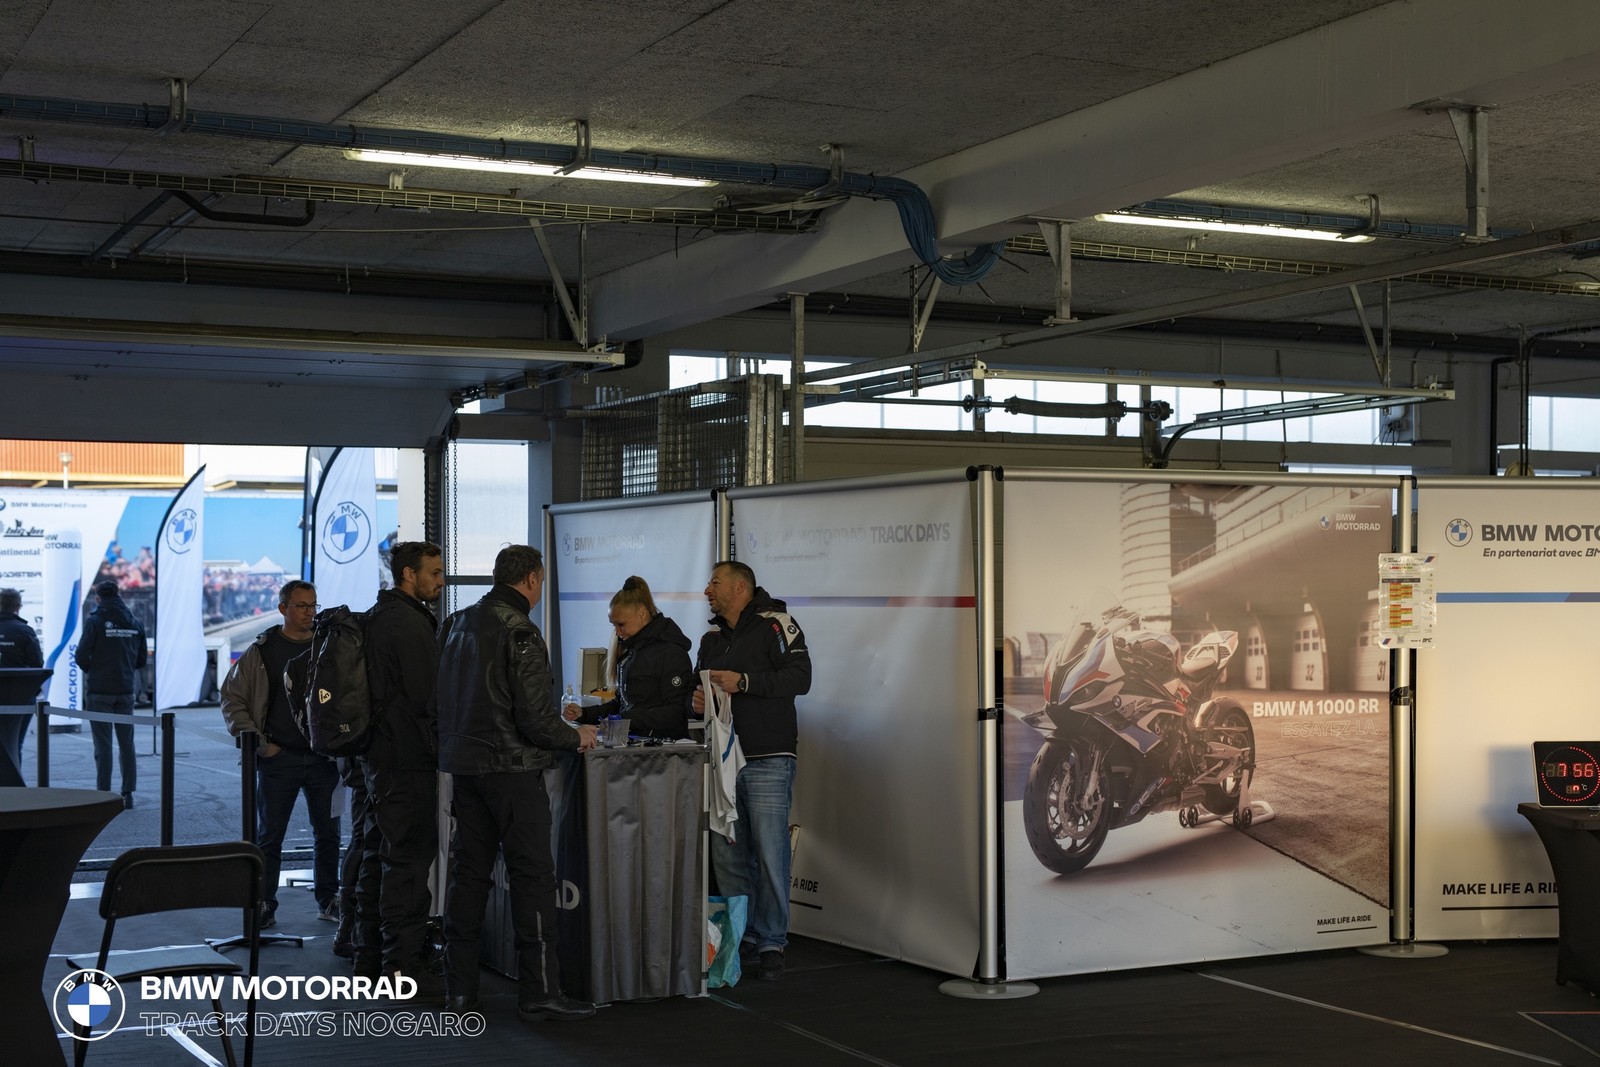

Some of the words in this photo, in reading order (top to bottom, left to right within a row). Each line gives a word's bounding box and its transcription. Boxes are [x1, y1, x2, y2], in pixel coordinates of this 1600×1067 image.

[1336, 513, 1356, 521] BMW
[871, 524, 914, 544] TRACK
[916, 522, 950, 542] DAYS
[1335, 522, 1381, 531] MOTORRAD
[1481, 525, 1537, 541] BMW
[574, 537, 594, 551] BMW
[1483, 548, 1496, 557] En
[1498, 548, 1557, 559] partenariat
[1377, 660, 1387, 681] 31
[69, 644, 77, 719] RACKDAYS
[1253, 701, 1296, 717] BMW
[1299, 700, 1314, 716] M
[1316, 699, 1356, 715] 1000
[1358, 698, 1380, 713] RR
[1282, 719, 1379, 737] ESSAYEZ-LA.
[793, 877, 799, 889] A
[799, 878, 819, 893] RIDE
[1442, 883, 1487, 895] MAKE
[1490, 883, 1520, 894] LIFE
[1524, 882, 1534, 894] A
[1317, 918, 1336, 926] MAKE
[1337, 916, 1350, 924] LIFE
[1357, 914, 1371, 922] RIDE
